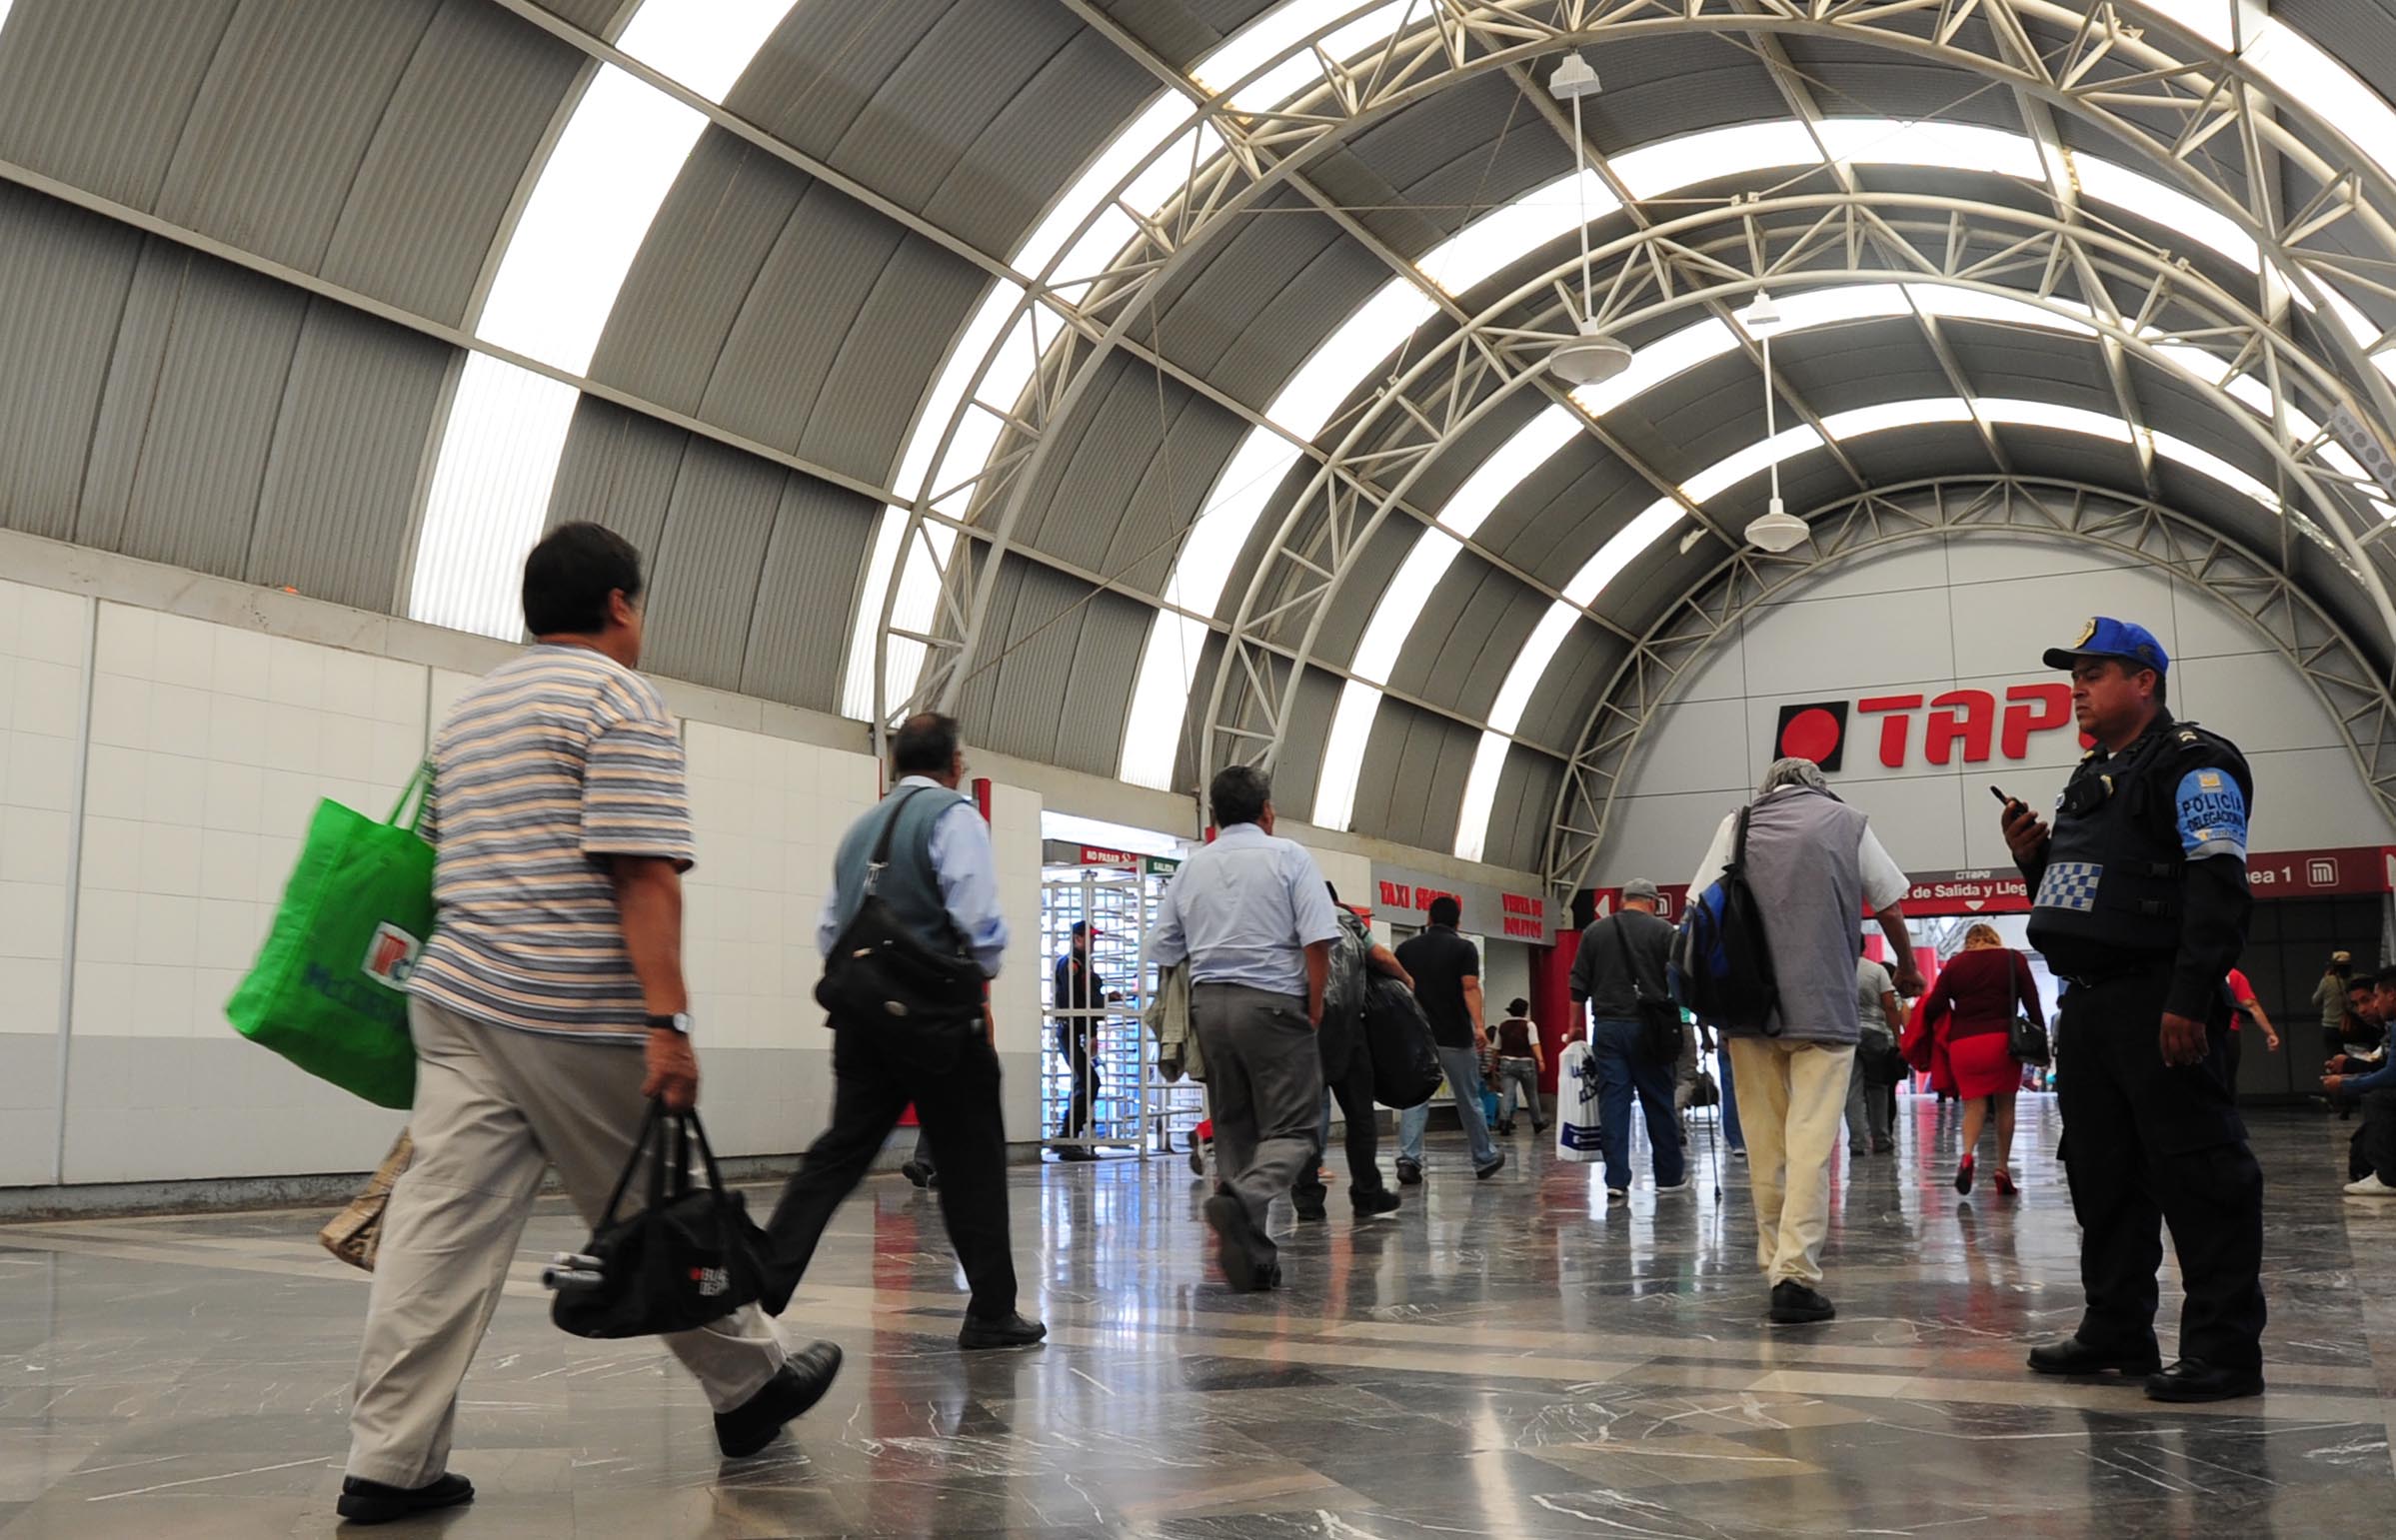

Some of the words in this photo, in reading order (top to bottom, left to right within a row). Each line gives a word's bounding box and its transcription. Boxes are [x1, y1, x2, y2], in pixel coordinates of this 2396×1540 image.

[1856, 683, 2097, 768] TAP
[1087, 850, 1098, 860] NO
[1099, 852, 1121, 863] PASAR
[1154, 861, 1175, 872] SALIDA
[2282, 865, 2292, 883] 1
[1379, 879, 1411, 909] TAXI
[1912, 886, 1931, 899] de
[1934, 883, 1980, 898] Salida
[1984, 884, 1993, 898] y
[1996, 881, 2027, 896] Lleg
[1502, 892, 1532, 915] VENTA
[1531, 898, 1542, 917] DE
[1503, 916, 1542, 939] BOLETOS
